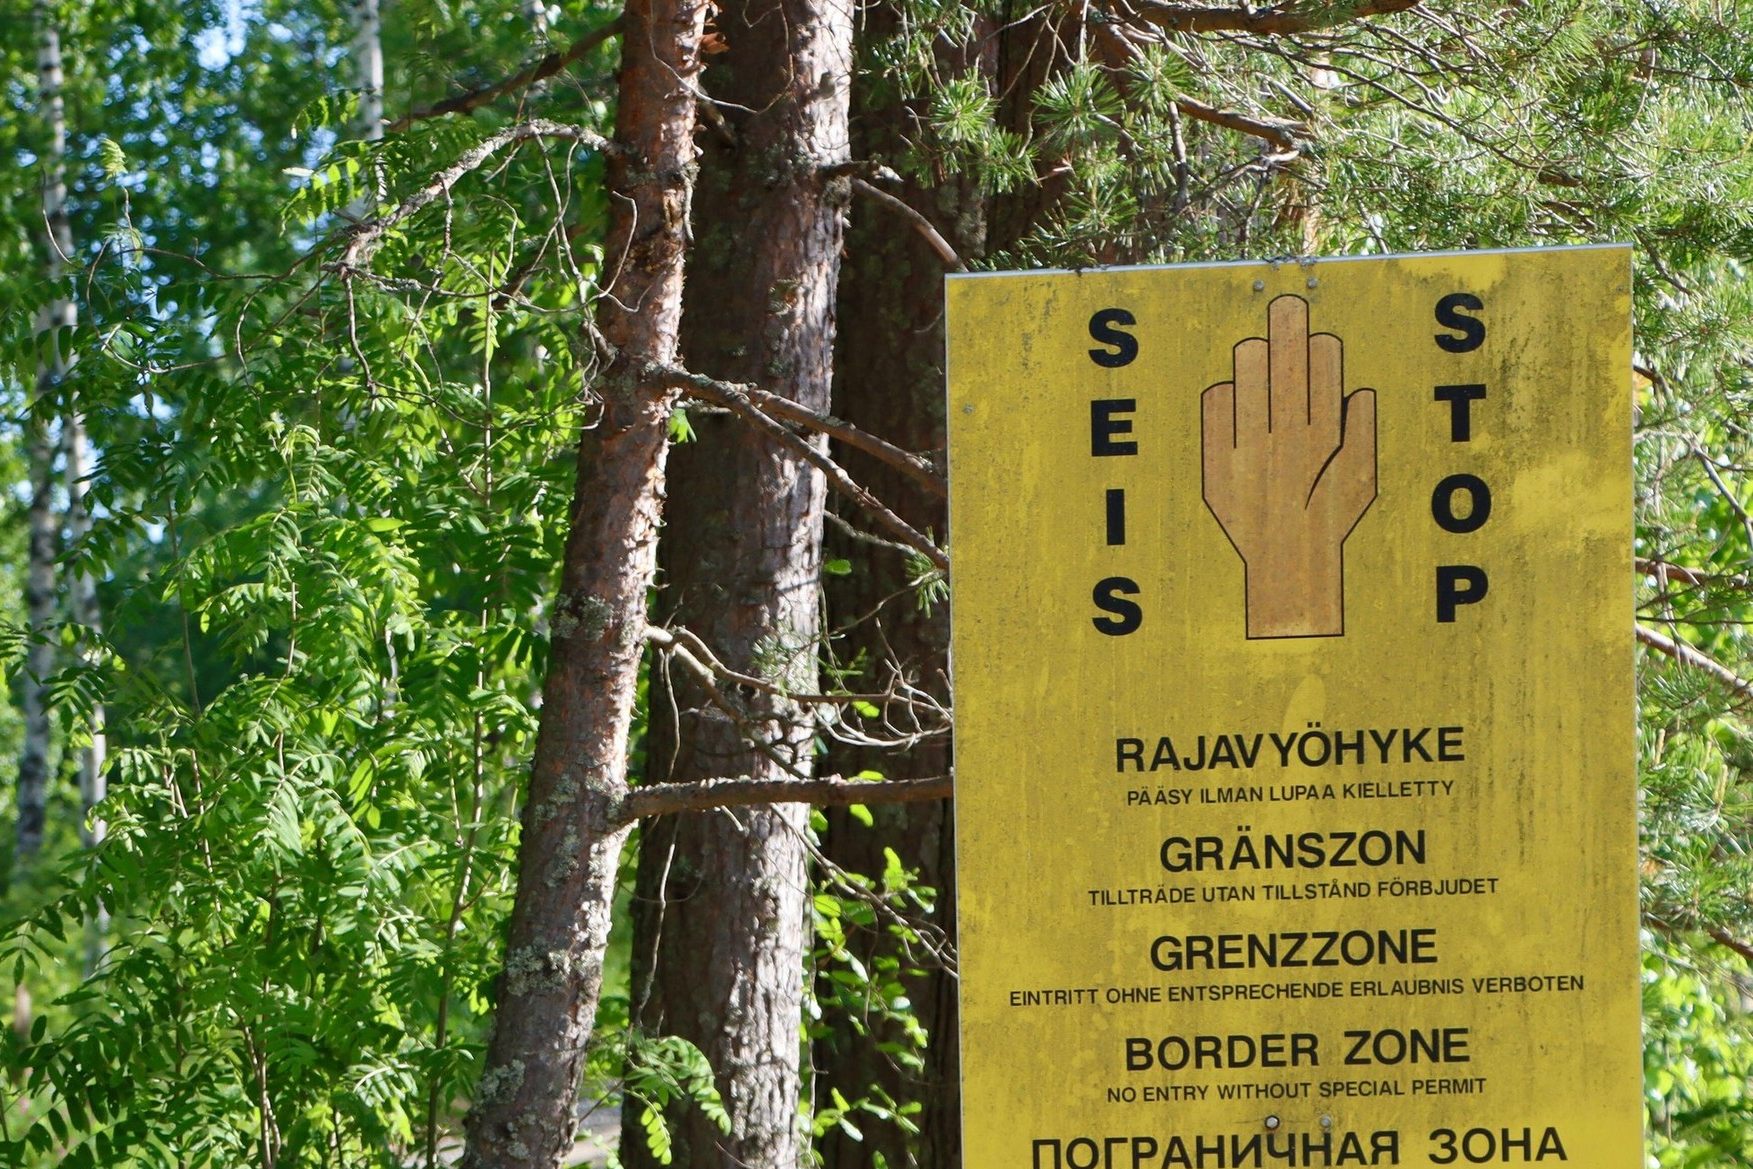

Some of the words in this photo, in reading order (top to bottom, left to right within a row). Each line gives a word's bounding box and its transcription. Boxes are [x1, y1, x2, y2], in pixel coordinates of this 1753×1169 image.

[1088, 307, 1143, 637] SEIS
[1430, 292, 1492, 623] STOP
[1116, 721, 1465, 773] RAJAVYÖHYKE
[1127, 786, 1193, 806] PÄÄSY
[1200, 786, 1263, 804] ILMAN
[1269, 784, 1336, 802] LUPAA
[1343, 780, 1454, 799] KIELLETTY
[1160, 825, 1426, 873] GRÄNSZON
[1087, 884, 1196, 906] TILLTRÄDE
[1202, 885, 1255, 903] UTAN
[1261, 878, 1371, 901] TILLSTÅND
[1377, 875, 1499, 897] FÖRBJUDET
[1150, 928, 1438, 972] GRENZZONE
[1010, 988, 1099, 1007] EINTRITT
[1106, 987, 1162, 1004] OHNE
[1168, 981, 1344, 1002] ENTSPRECHENDE
[1350, 978, 1465, 997] ERLAUBNIS
[1471, 975, 1584, 994] VERBOTEN
[1125, 1032, 1319, 1072] BORDER
[1343, 1027, 1470, 1066] ZONE
[1107, 1086, 1137, 1103] NO
[1143, 1085, 1209, 1102] ENTRY
[1217, 1082, 1312, 1100] WITHOUT
[1318, 1080, 1405, 1099] SPECIAL
[1412, 1077, 1487, 1095] PERMIT
[1428, 1126, 1568, 1165] ЗОНА
